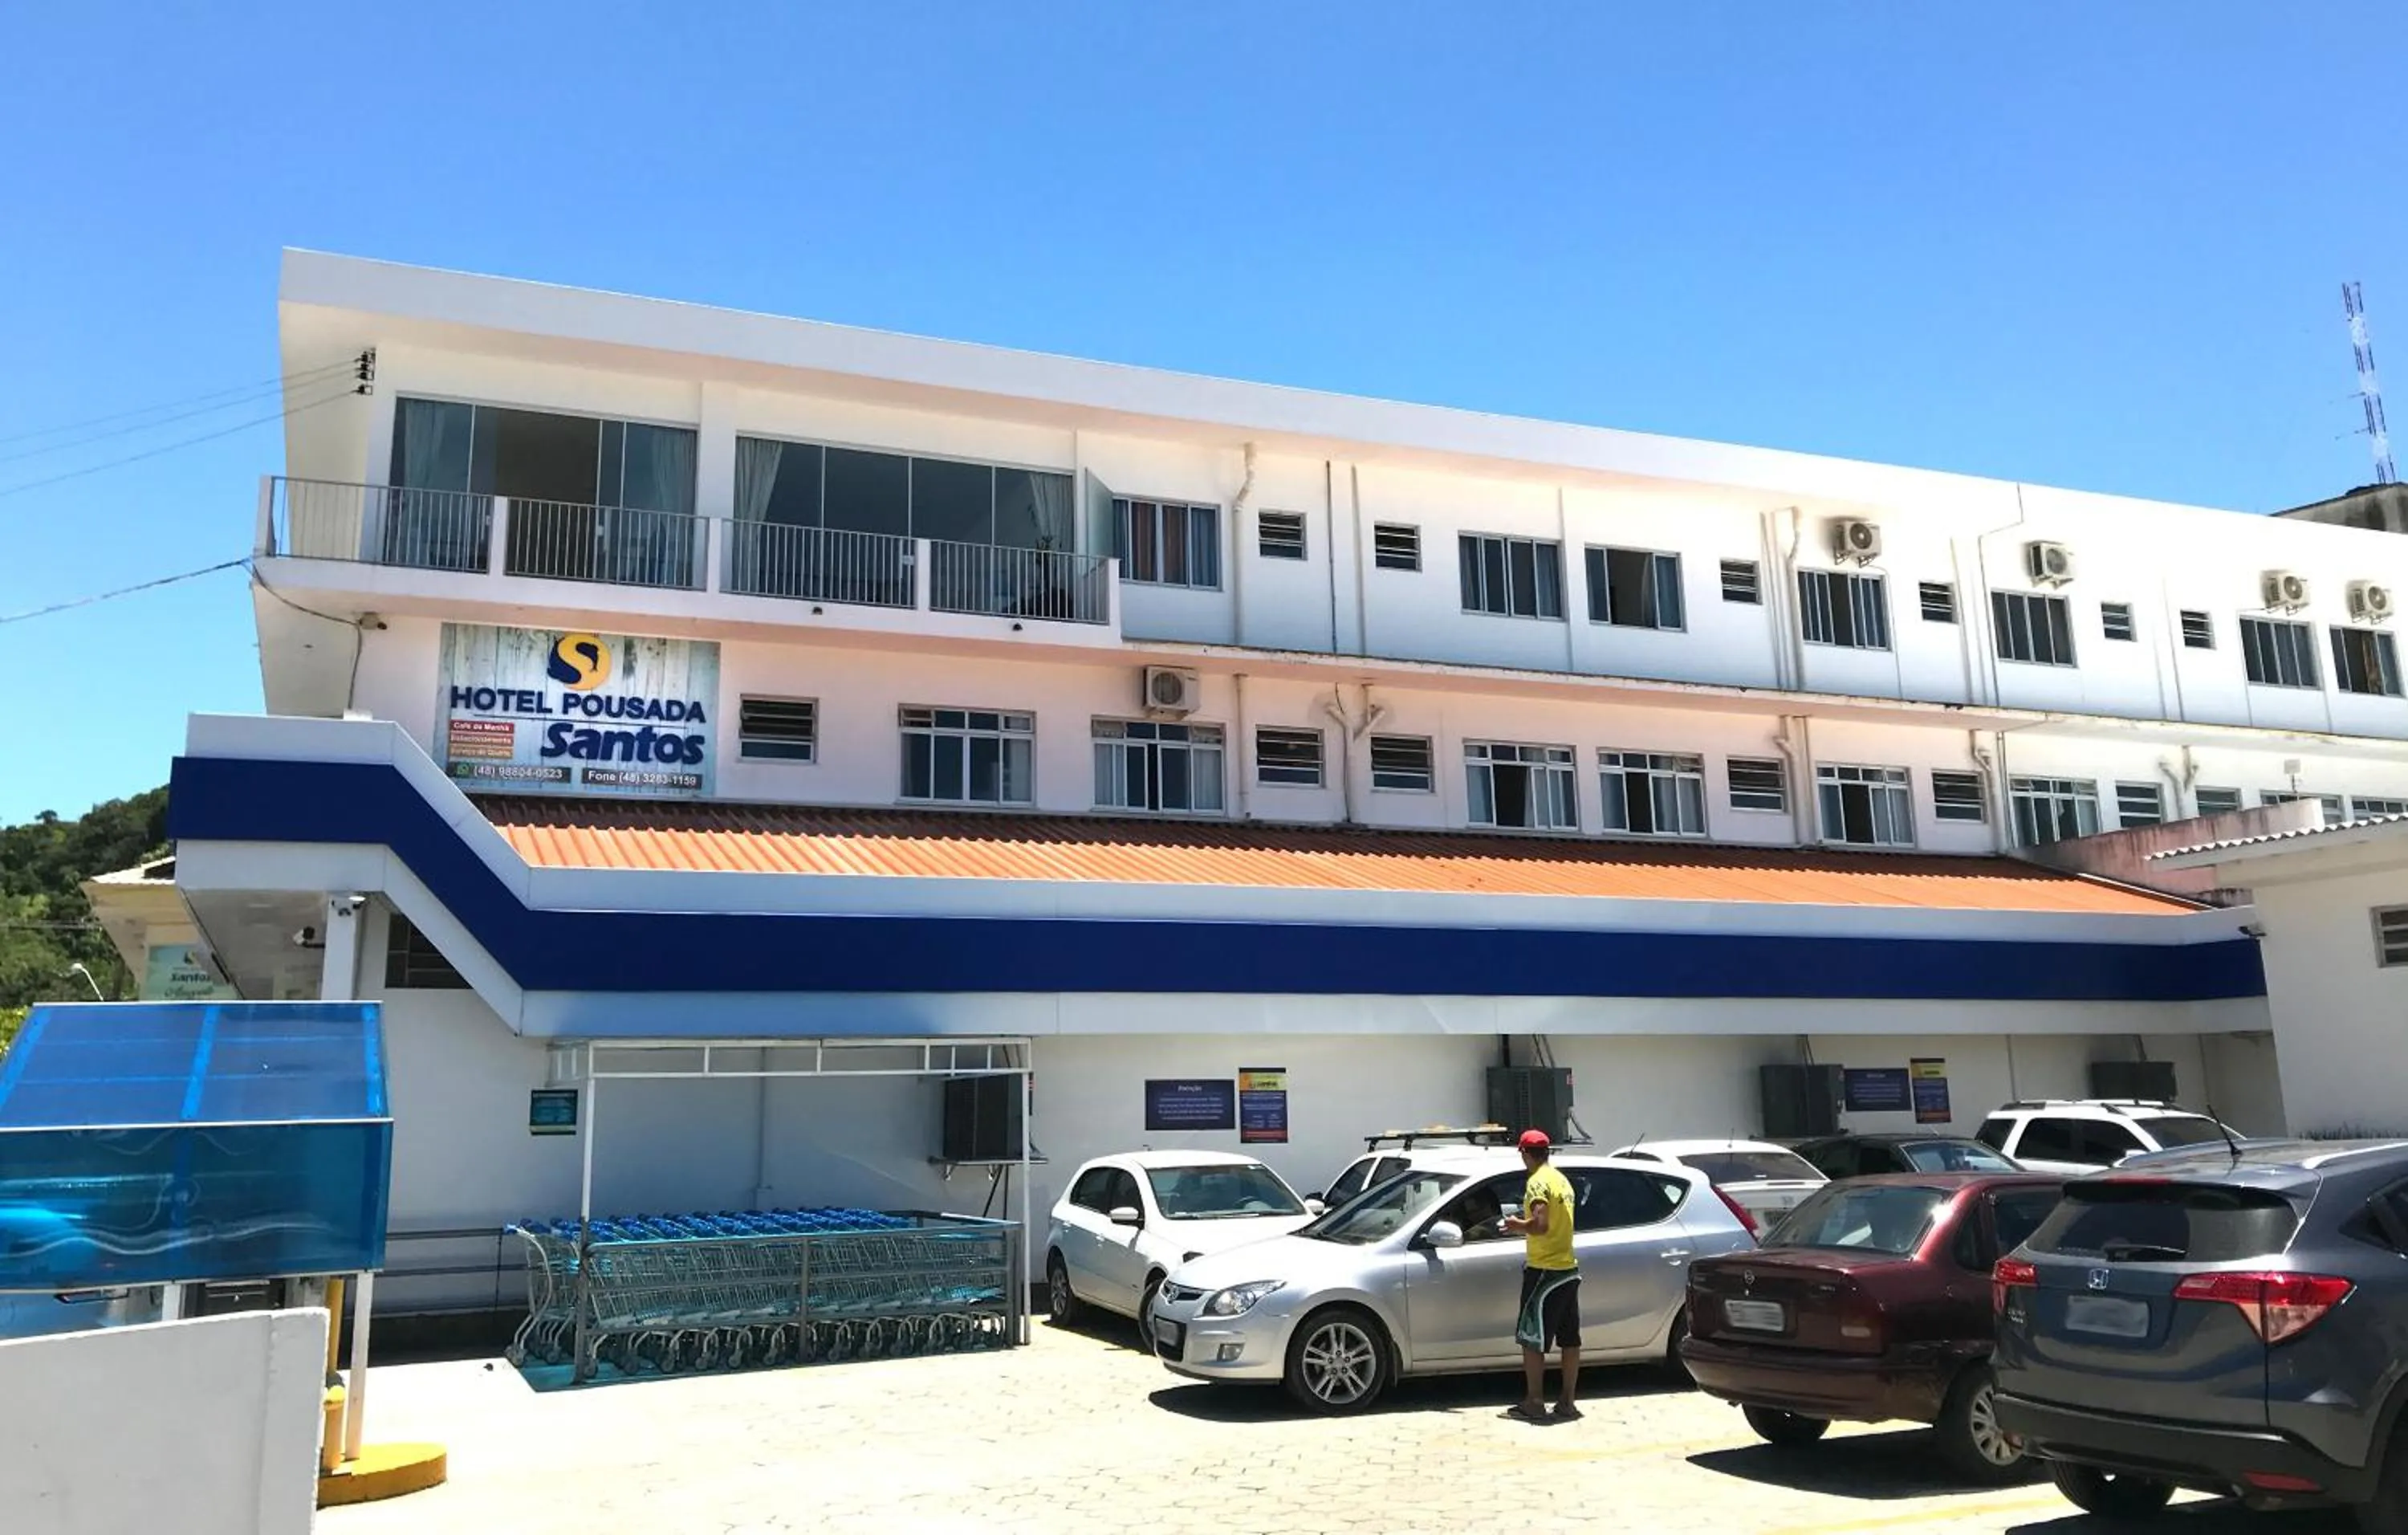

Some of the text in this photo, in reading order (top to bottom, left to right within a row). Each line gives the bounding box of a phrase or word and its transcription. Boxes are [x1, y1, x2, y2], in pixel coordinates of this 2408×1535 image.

[450, 686, 706, 723] HOTEL POUSADA
[540, 723, 706, 765] Santos
[588, 770, 616, 781] Fone
[619, 772, 640, 784] (48)
